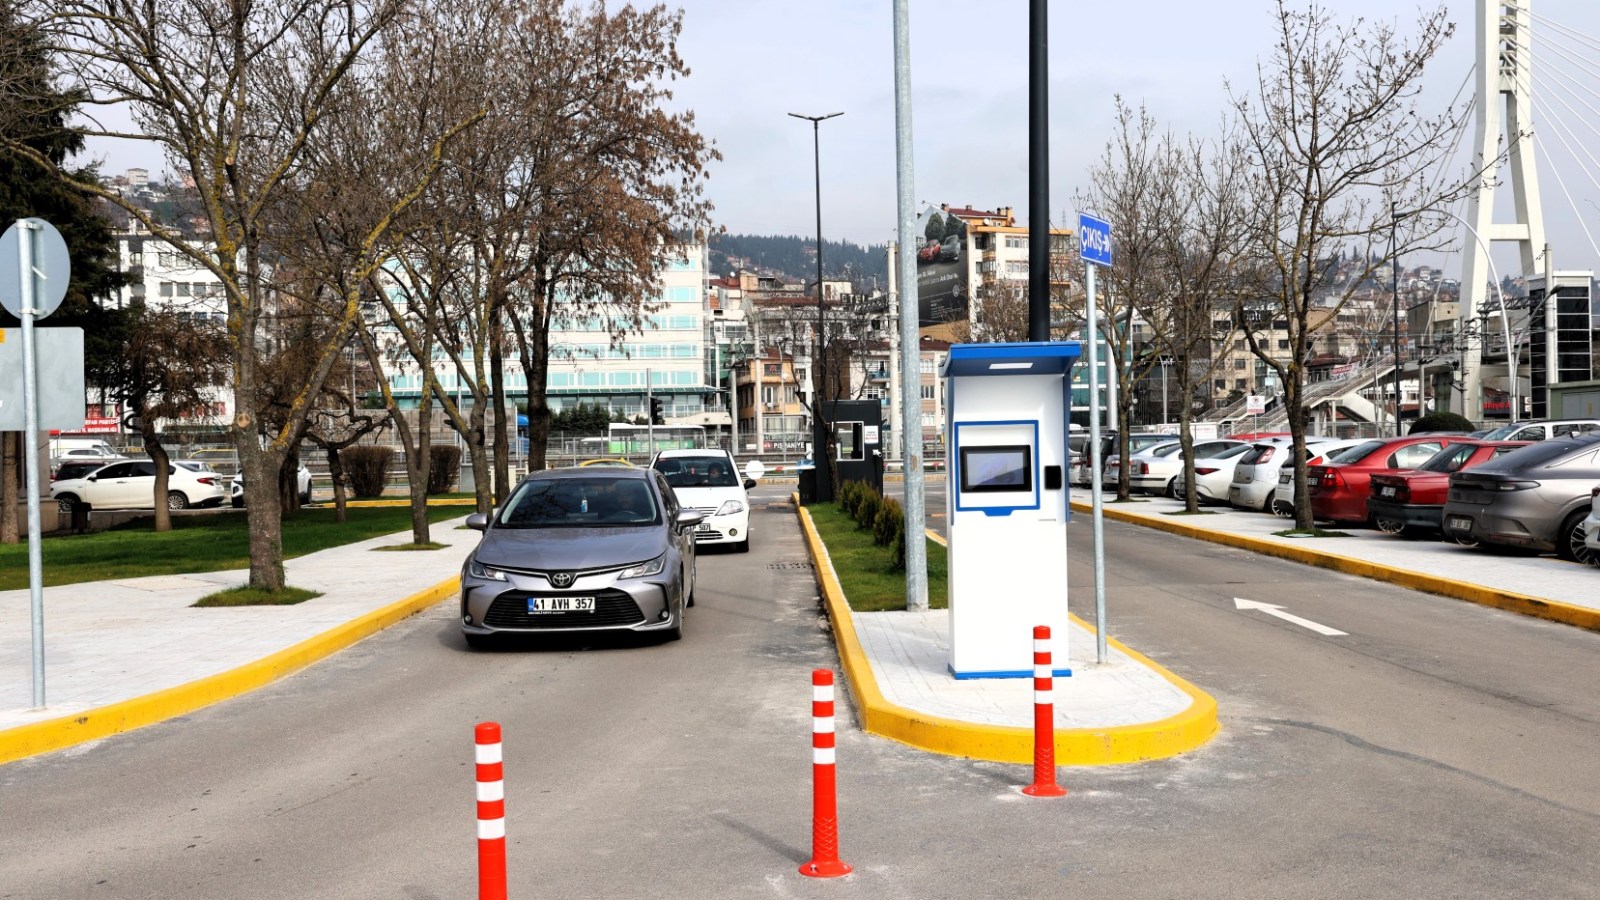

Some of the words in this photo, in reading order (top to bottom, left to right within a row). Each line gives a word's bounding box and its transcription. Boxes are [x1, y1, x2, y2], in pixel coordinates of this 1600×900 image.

[1081, 225, 1102, 256] ÇIKIŞ
[533, 599, 545, 610] 41
[551, 598, 570, 610] AVH
[575, 598, 593, 609] 357
